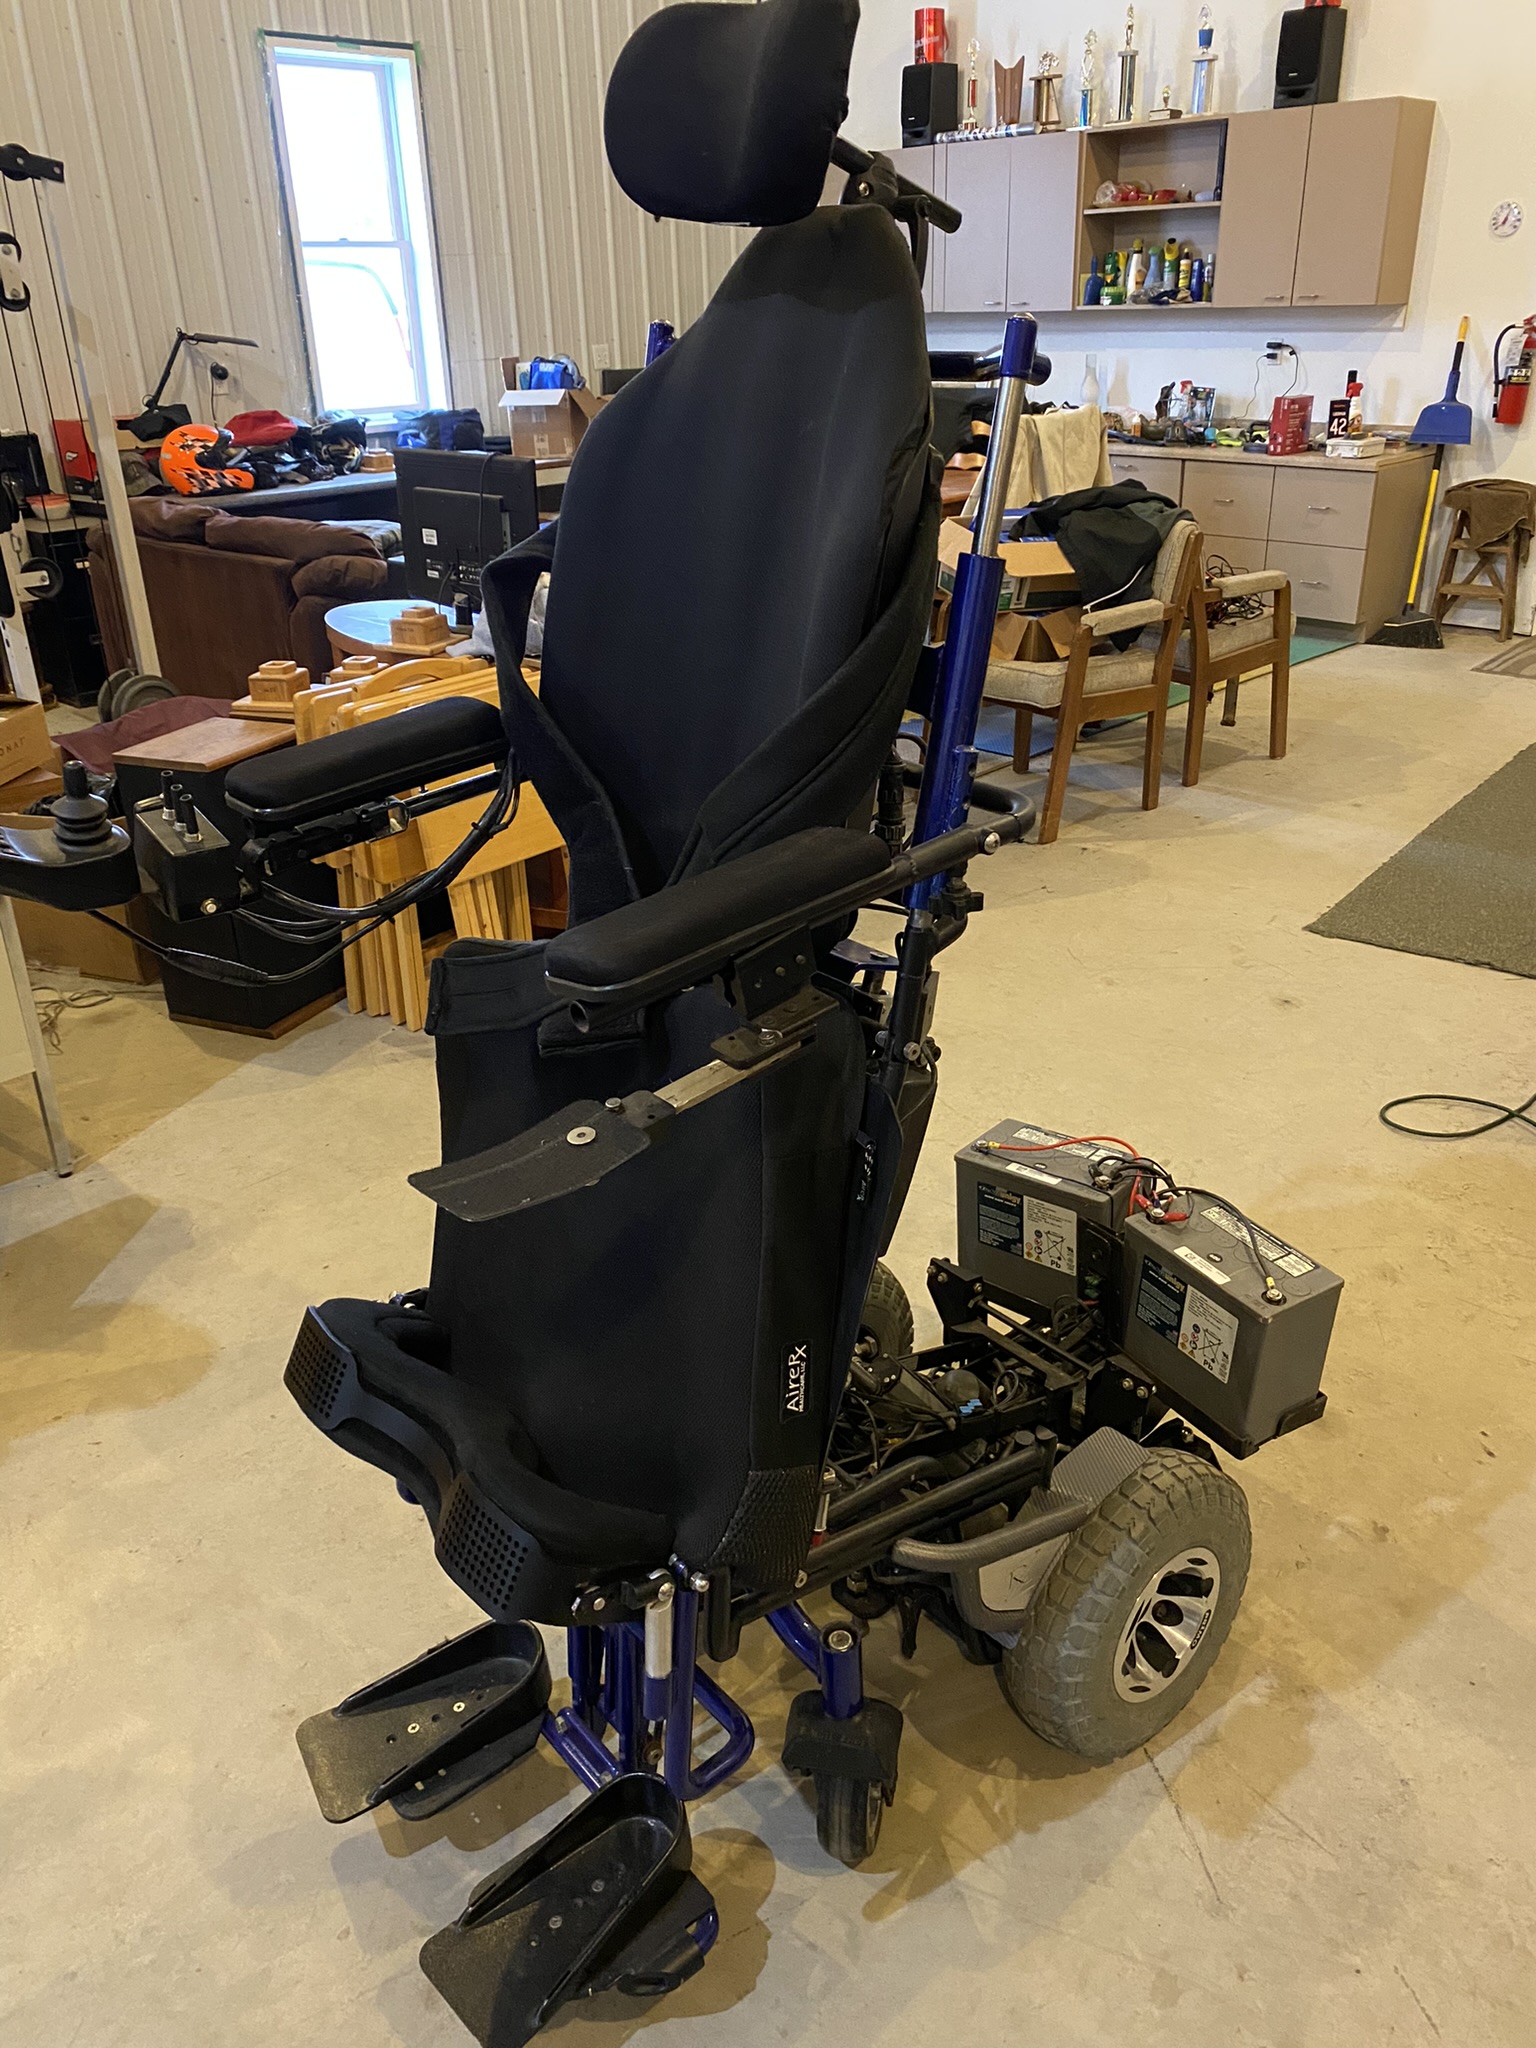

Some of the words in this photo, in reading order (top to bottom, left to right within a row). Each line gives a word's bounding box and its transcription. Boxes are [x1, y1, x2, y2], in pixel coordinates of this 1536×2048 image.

[1329, 417, 1348, 435] 42
[1050, 1259, 1062, 1269] Pb
[1203, 1359, 1214, 1371] Pb
[786, 1344, 807, 1412] AireRx
